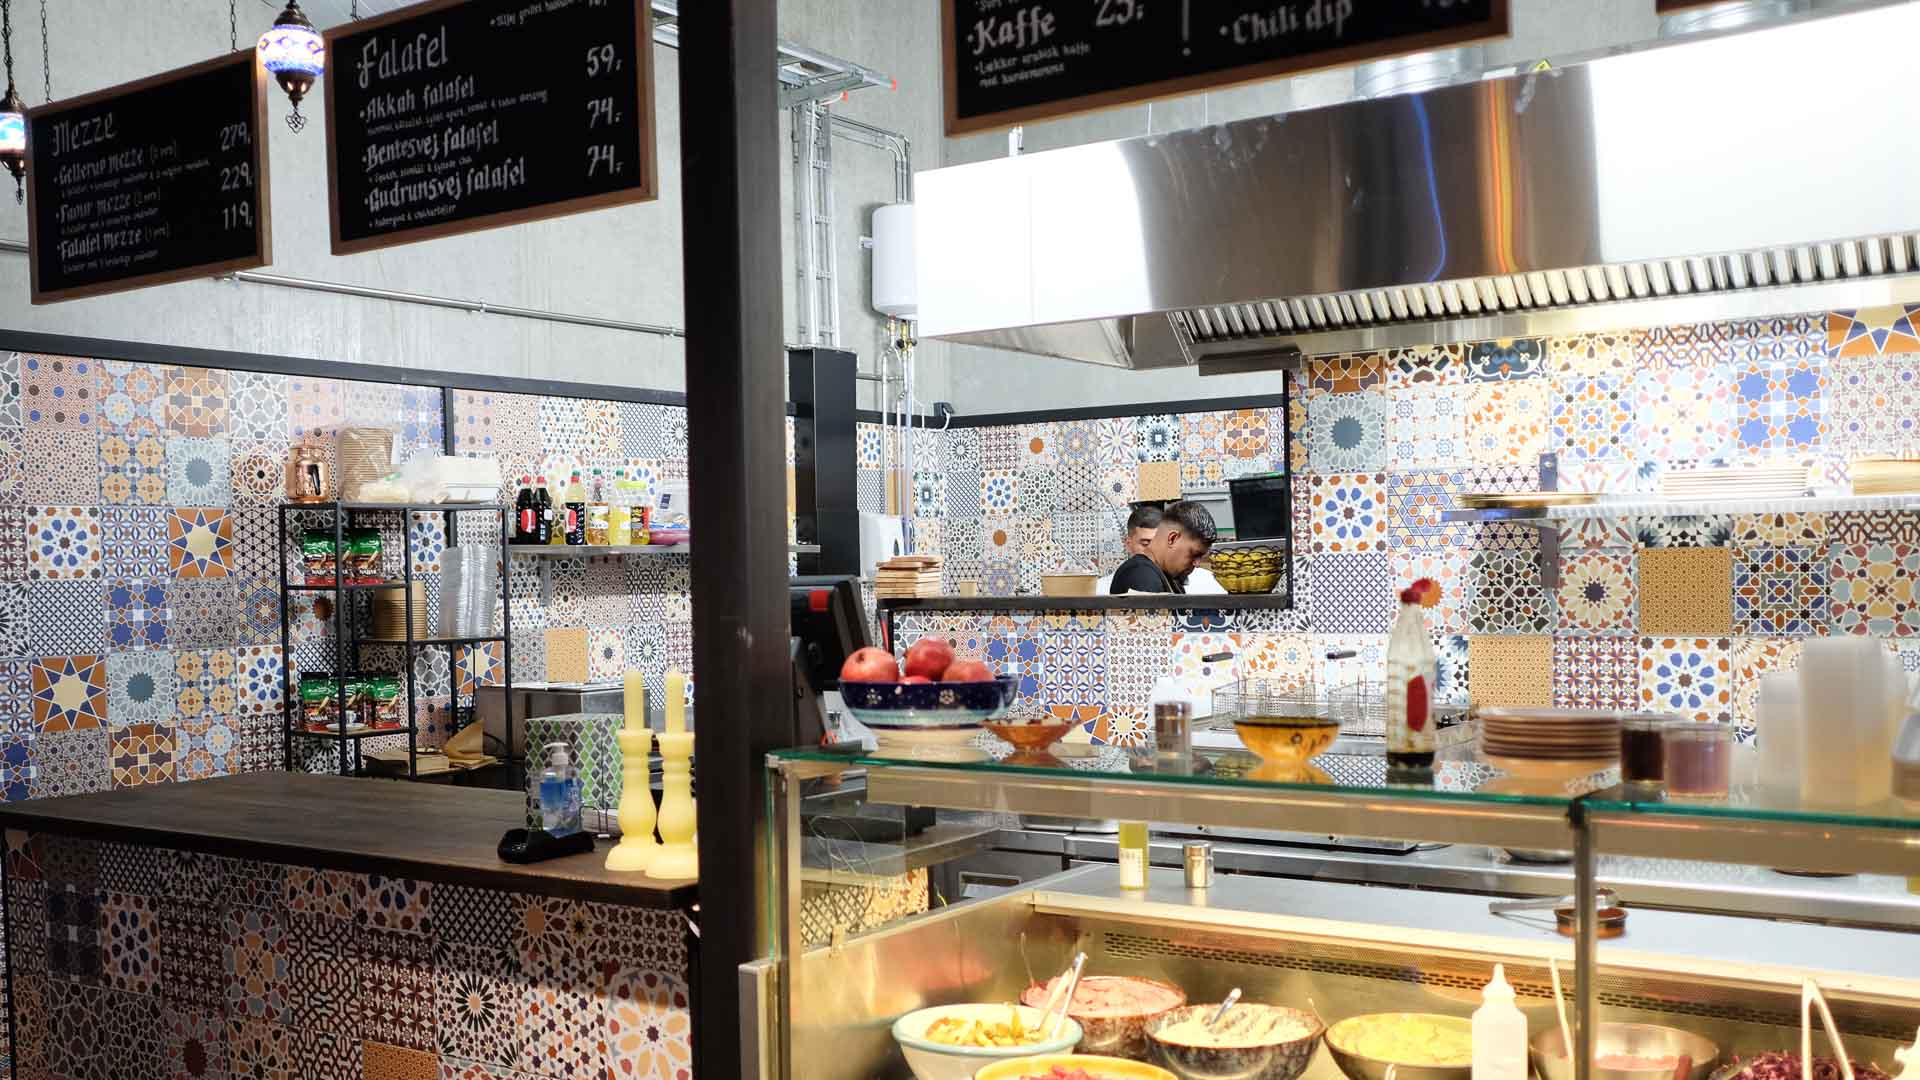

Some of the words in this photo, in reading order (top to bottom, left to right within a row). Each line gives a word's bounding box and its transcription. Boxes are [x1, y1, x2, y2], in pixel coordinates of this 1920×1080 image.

[973, 5, 1056, 56] Kaffe
[1232, 5, 1298, 45] Chili
[1303, 0, 1352, 38] dip
[357, 25, 448, 88] Falafel
[366, 88, 415, 123] Akkah
[422, 75, 475, 112] falafel
[53, 112, 116, 157] Mezze
[366, 131, 438, 173] Bentesvej
[442, 120, 499, 158] falafel
[369, 172, 462, 213] Gudrunsvej
[466, 156, 526, 196] falafel
